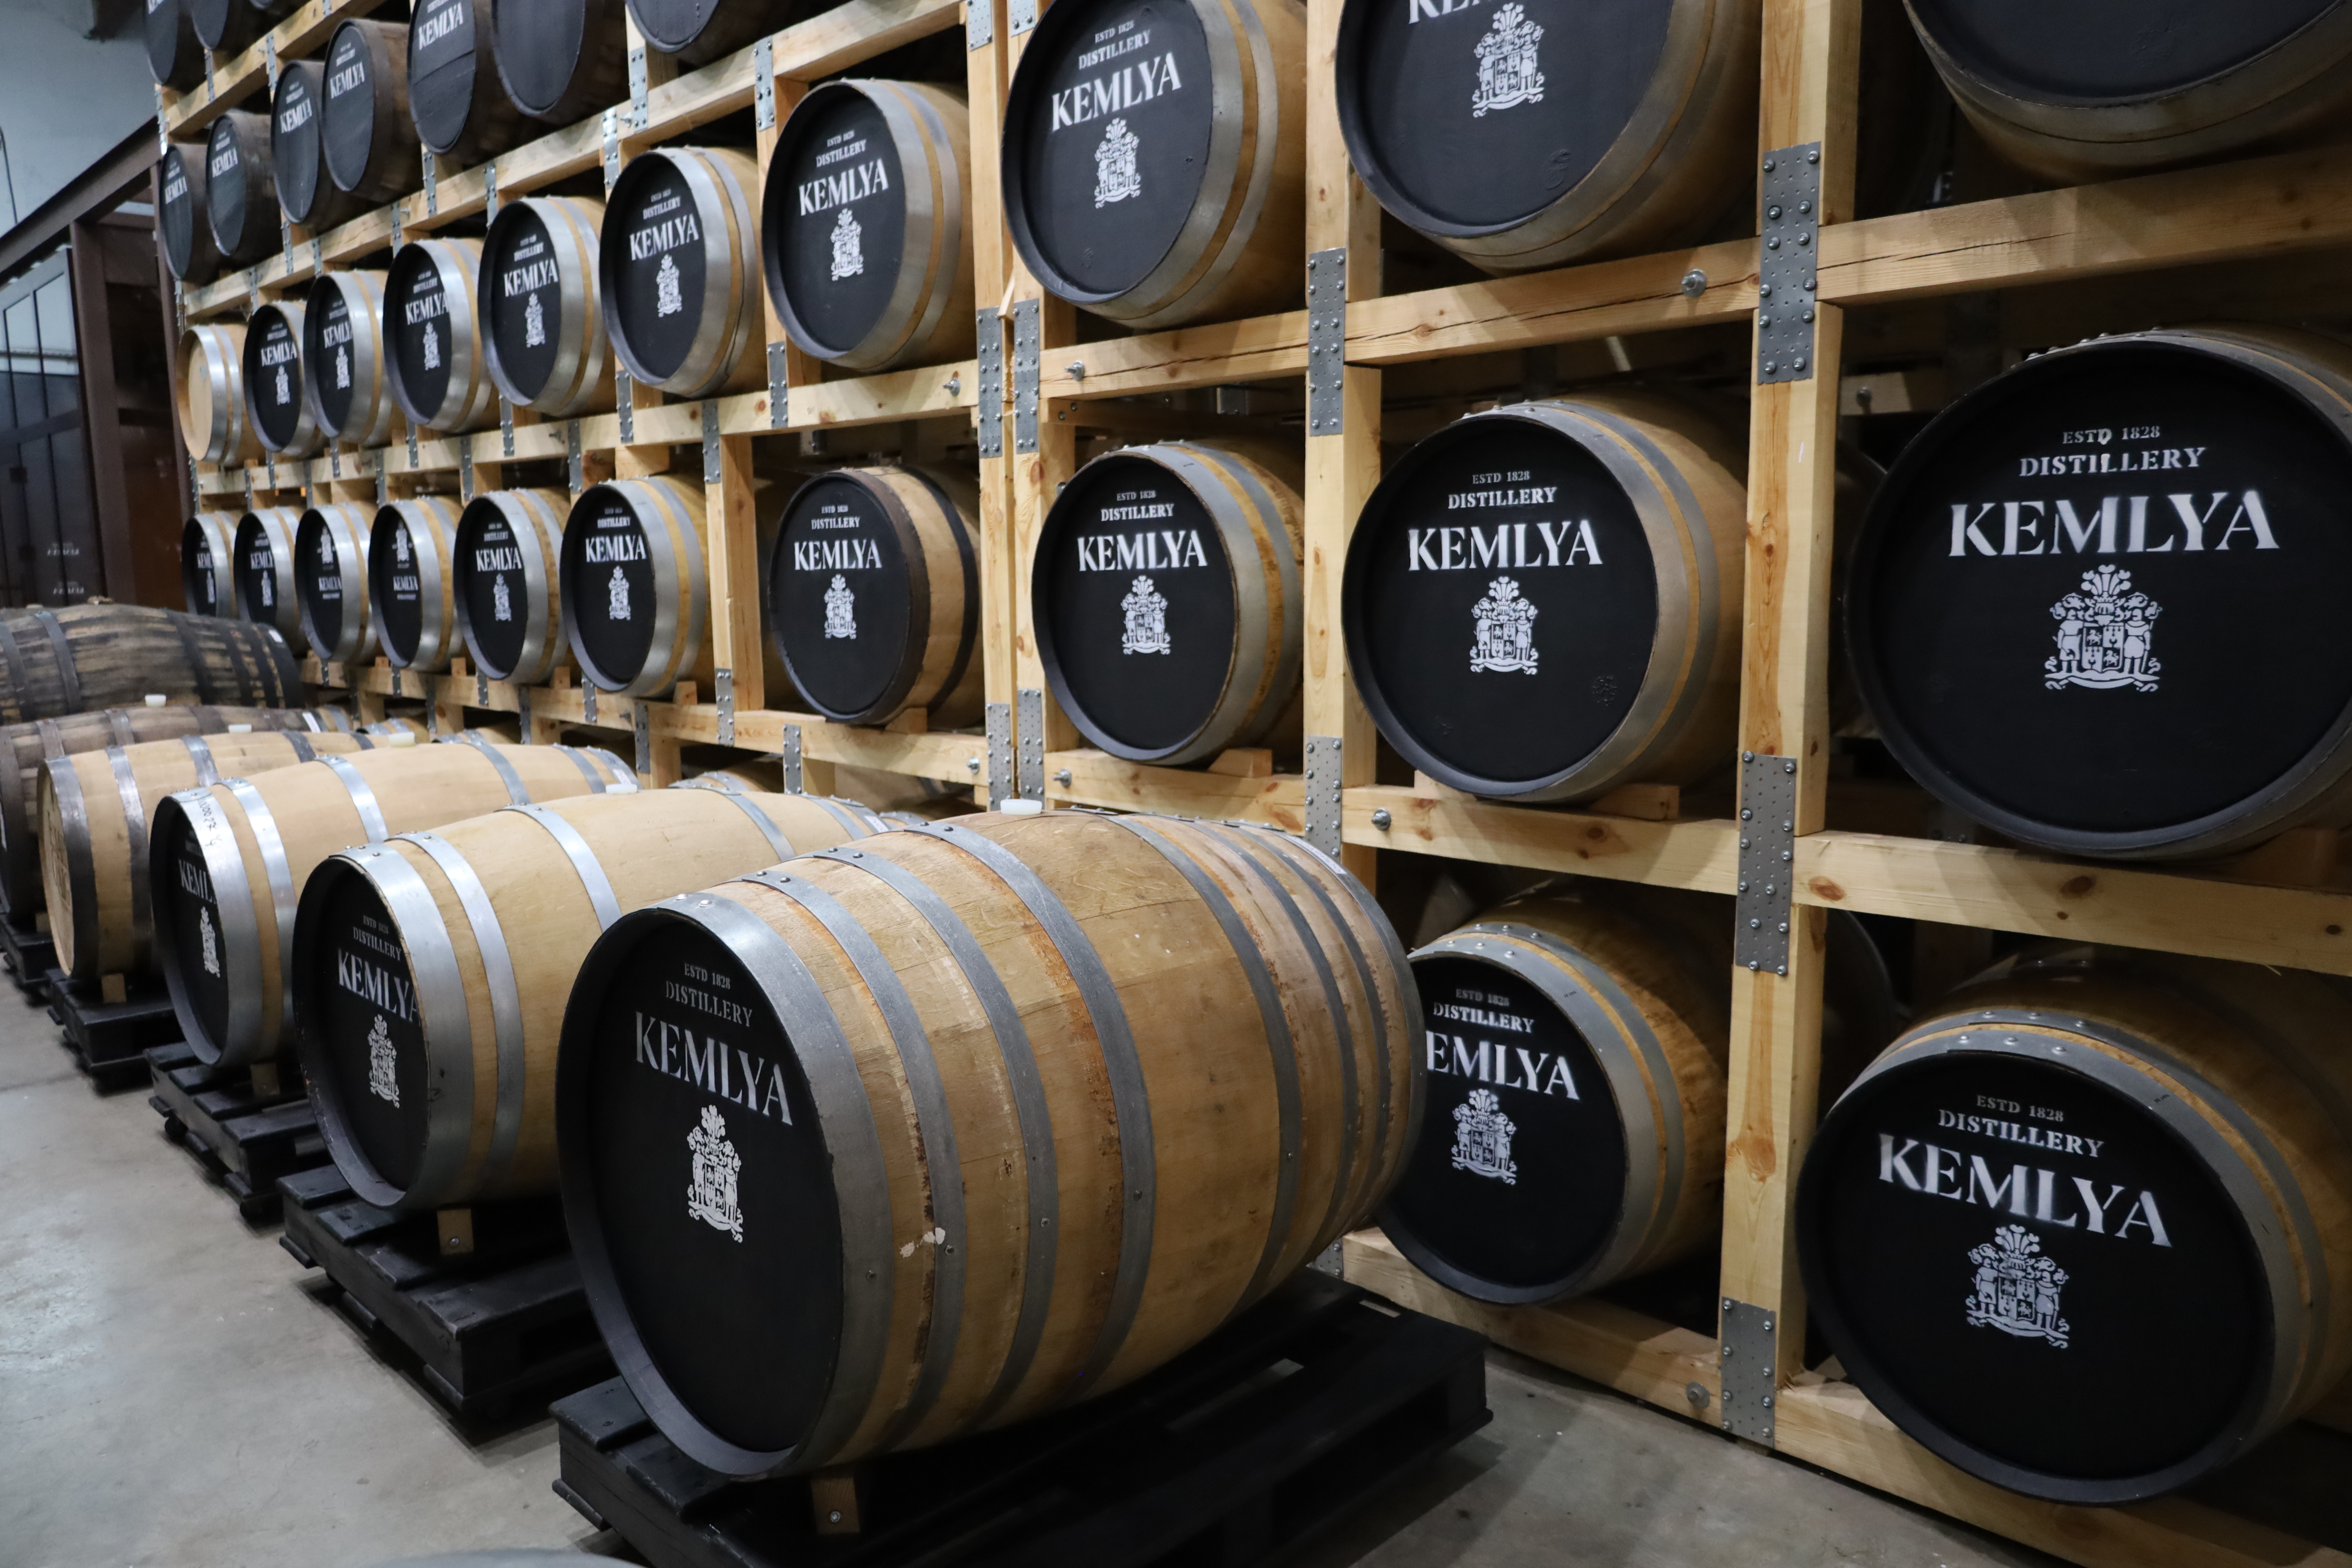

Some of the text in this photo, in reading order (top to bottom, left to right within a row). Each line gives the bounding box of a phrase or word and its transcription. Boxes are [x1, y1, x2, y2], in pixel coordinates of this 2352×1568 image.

[418, 2, 464, 50] KEMLYA
[1095, 28, 1115, 43] ESTD
[1079, 30, 1150, 70] DISTILLERY
[330, 62, 365, 99] KEMLYA
[1052, 52, 1182, 132] KEMLYA
[816, 139, 866, 168] DISTILLERY
[827, 135, 842, 147] ESTD
[799, 158, 889, 216] KEMLYA
[643, 196, 681, 219] DISTILLERY
[629, 214, 699, 260] KEMLYA
[504, 258, 559, 297] KEMLYA
[406, 291, 449, 325] KEMLYA
[261, 341, 297, 367] KEMLYA
[2063, 426, 2160, 445] ESTD 1828
[2019, 447, 2206, 477] DISTILLERY
[1472, 471, 1530, 484] ESTD 1828
[822, 505, 836, 514] ESTD
[1117, 490, 1156, 501] ESTD 1828
[1448, 487, 1557, 509] DISTILLERY
[811, 516, 860, 530] DISTILLERY
[1101, 504, 1174, 521] DISTILLERY
[1949, 490, 2279, 557] KEMLYA
[251, 550, 274, 570] KEMLY
[476, 547, 522, 572] KEMLYA
[585, 534, 647, 563] KEMLYA
[794, 538, 882, 571] KEMLYA
[1077, 530, 1208, 571] KEMLYA
[1408, 520, 1603, 571] KEMLYA
[353, 926, 401, 961] DISTILLERY
[684, 963, 730, 990] ESTD 1828
[665, 981, 753, 1027] DISTILLERY
[1456, 989, 1510, 1006] ESTD 1828
[1433, 1002, 1535, 1033] DISTILLERY
[635, 1011, 793, 1126] KEMLYA
[1426, 1030, 1580, 1100] EMLYA
[1977, 1095, 2064, 1122] ESTD 1828
[1939, 1109, 2104, 1158] DISTILLERY
[1879, 1133, 2173, 1248] KEMLYA
